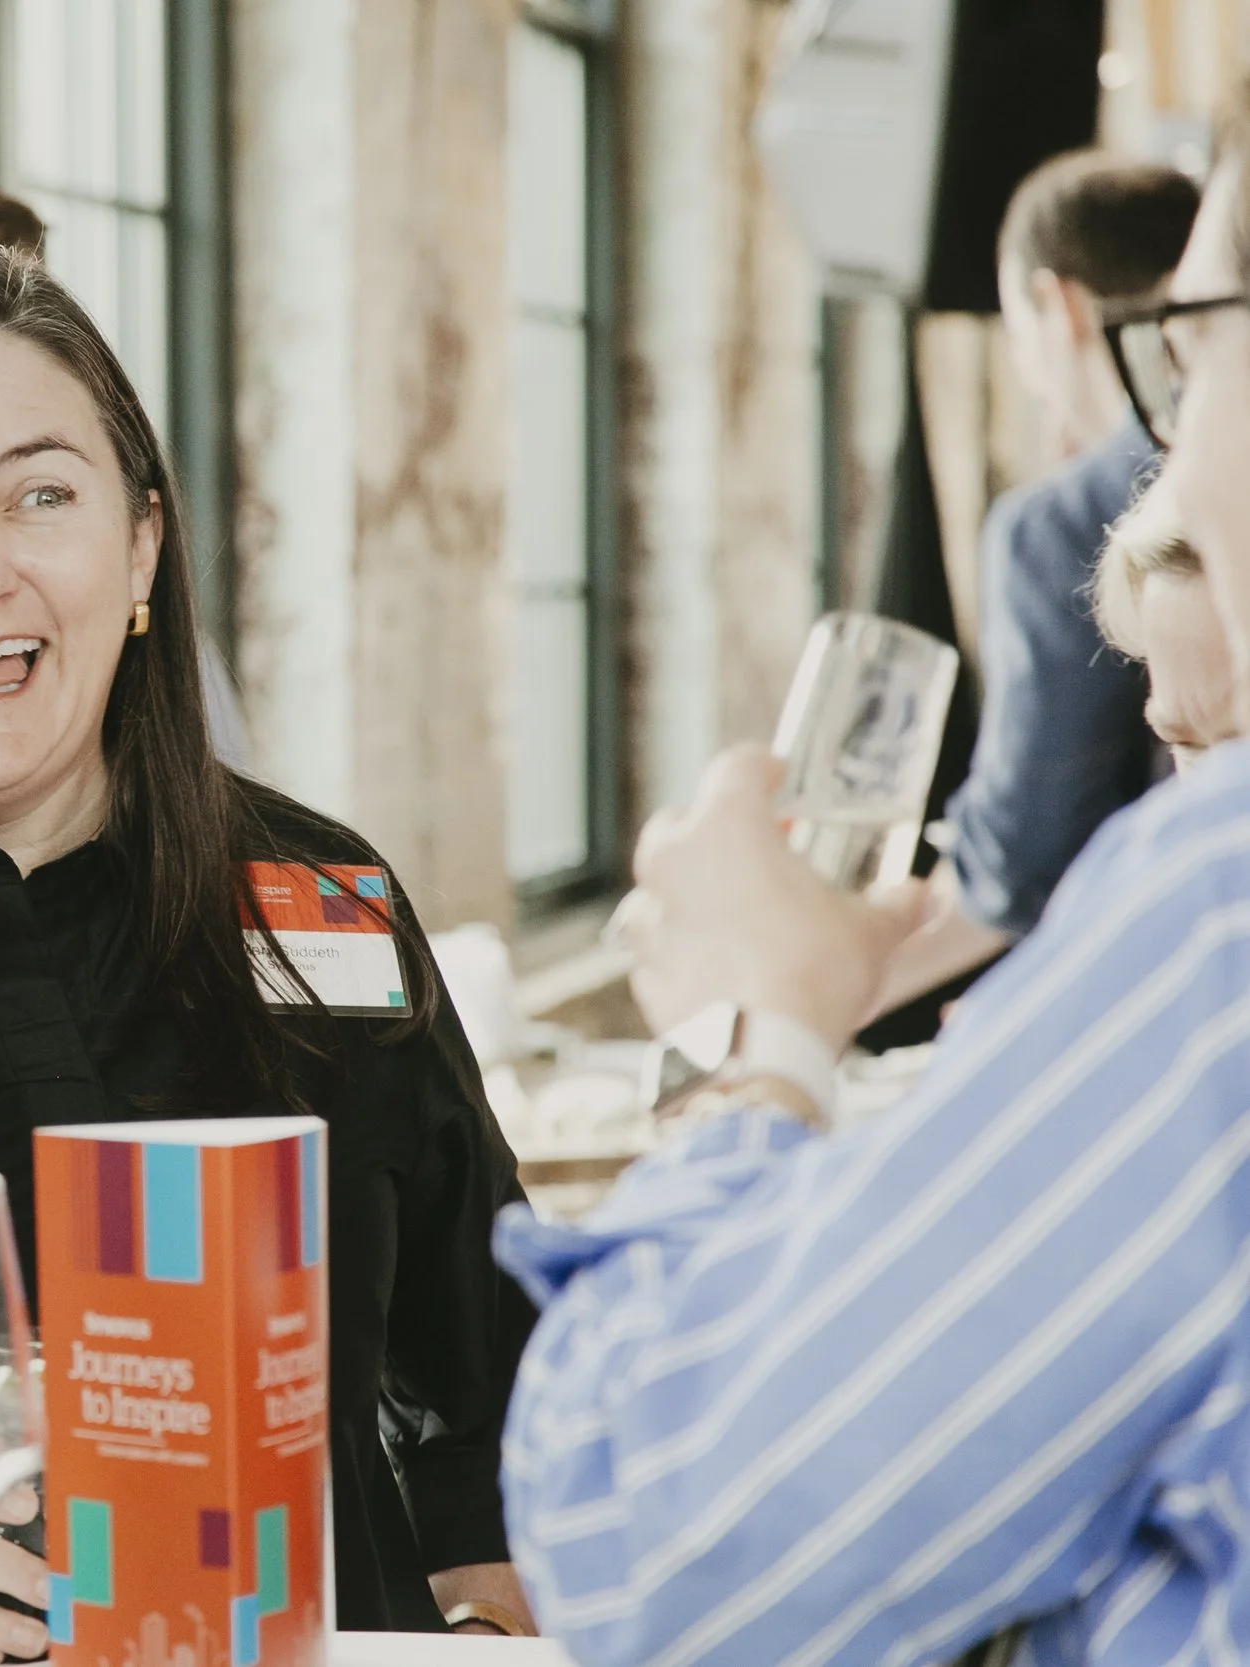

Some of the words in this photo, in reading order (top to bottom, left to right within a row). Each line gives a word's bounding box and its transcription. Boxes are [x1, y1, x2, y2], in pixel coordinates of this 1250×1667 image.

[281, 944, 341, 959] Suddeth
[67, 1340, 195, 1396] Journeys
[80, 1387, 110, 1424] to
[111, 1387, 211, 1439] Inspire
